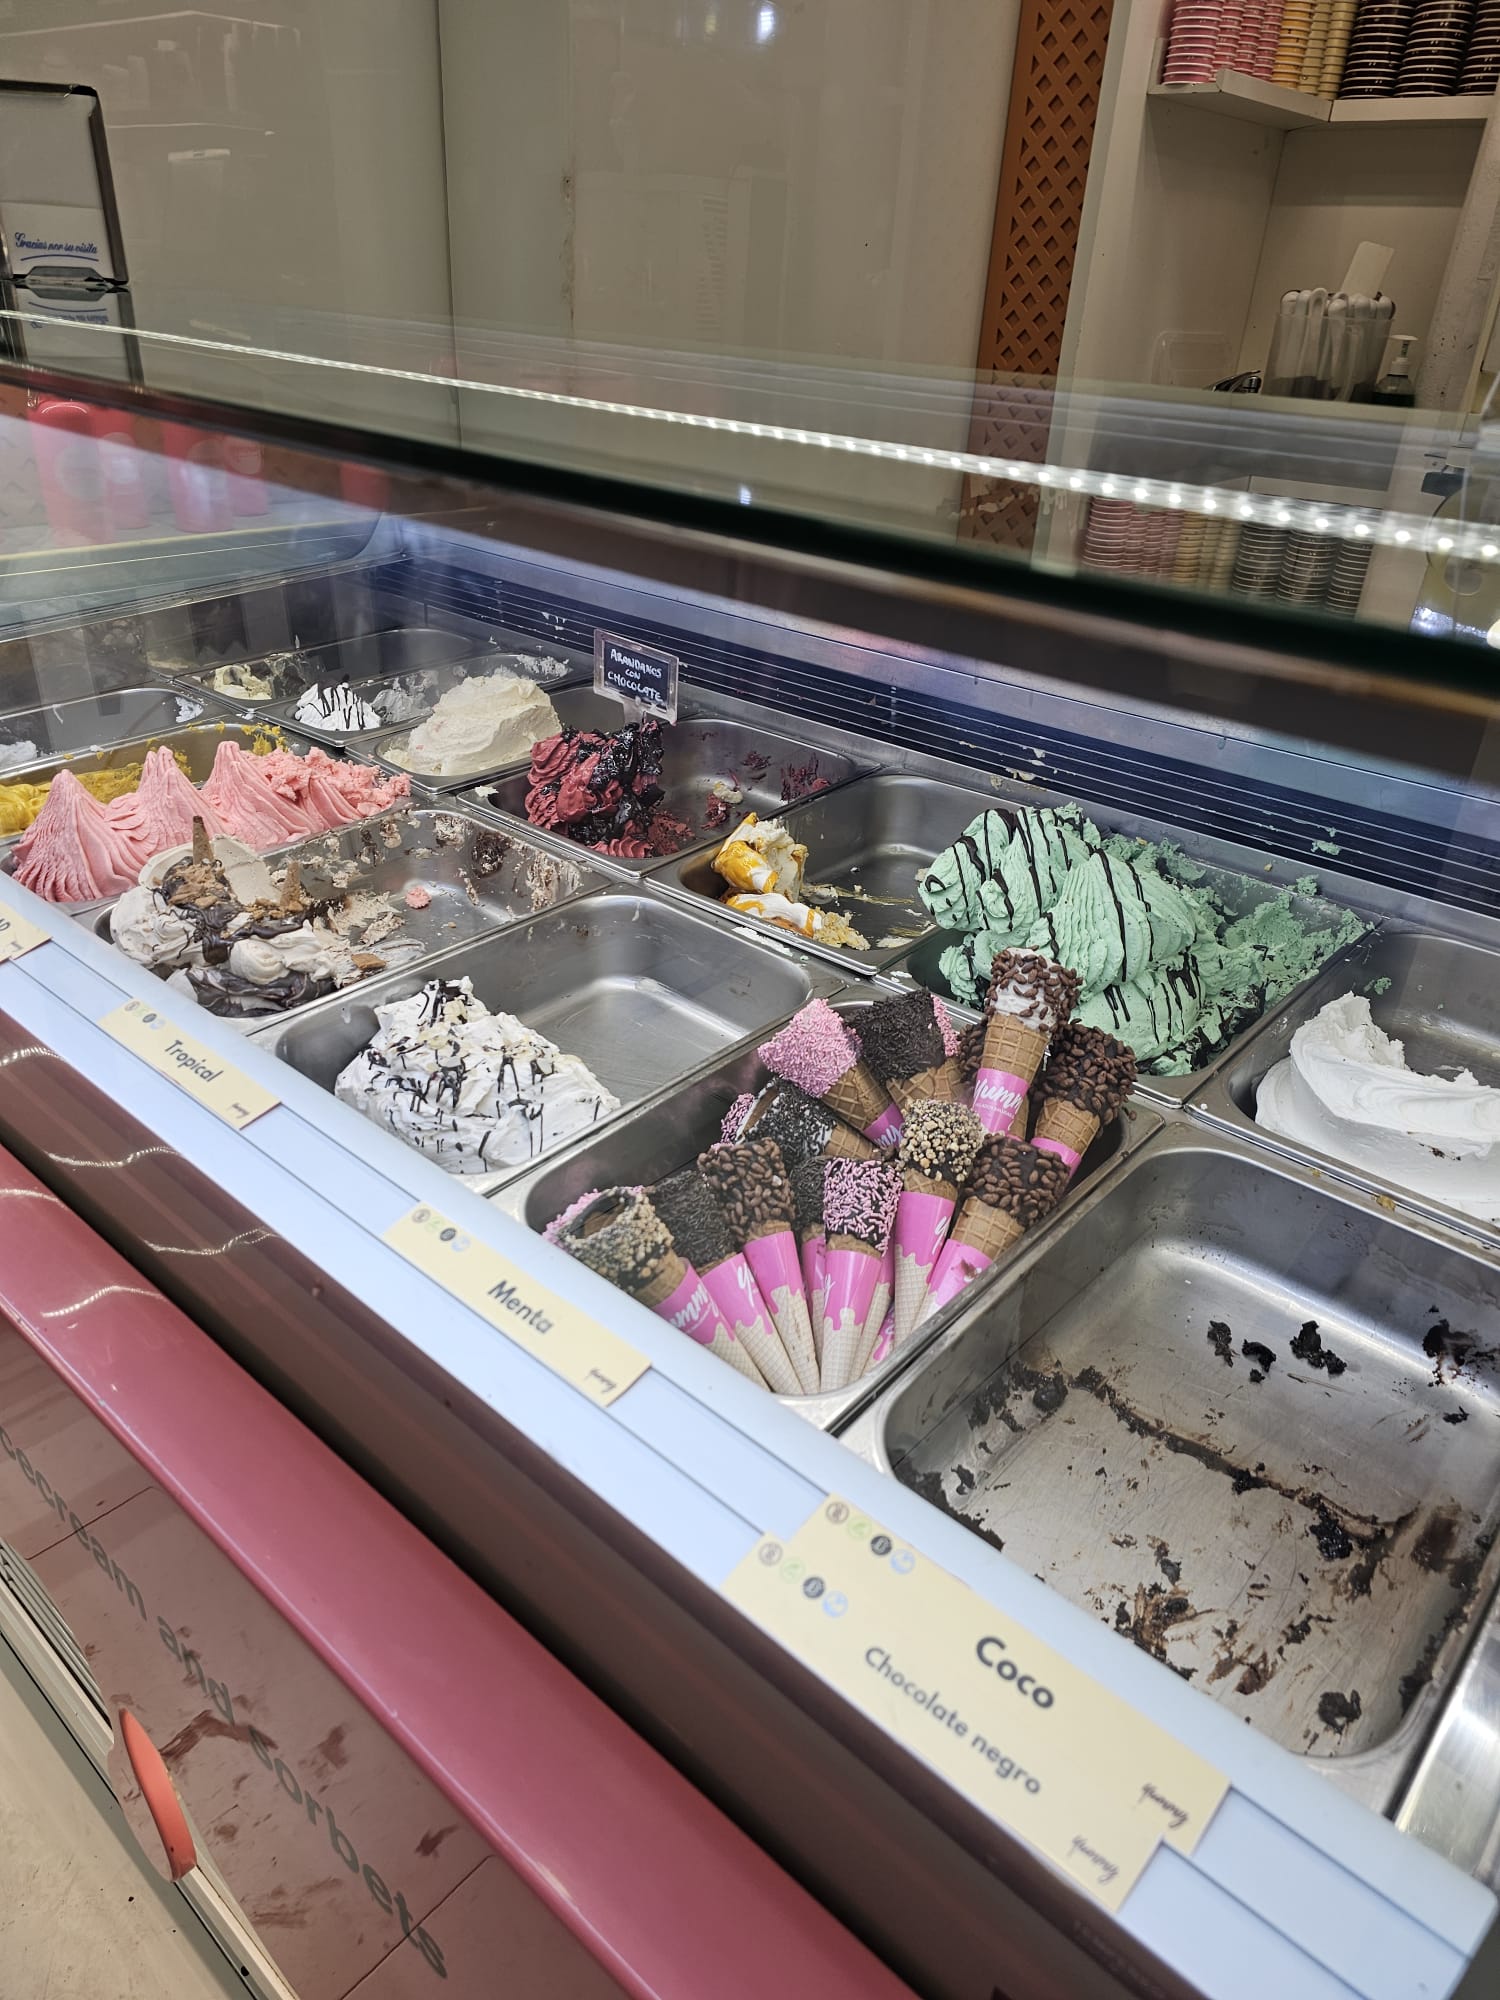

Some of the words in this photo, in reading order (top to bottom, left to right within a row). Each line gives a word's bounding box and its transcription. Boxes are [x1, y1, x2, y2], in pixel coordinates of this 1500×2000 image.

[14, 232, 48, 250] Gracias
[608, 671, 664, 702] CHOCOLATE
[625, 668, 640, 680] CON
[164, 1039, 223, 1083] Tropical
[486, 1280, 553, 1335] Menta
[976, 1635, 1054, 1710] Coco
[865, 1647, 969, 1737] Chocolate
[971, 1733, 1041, 1795] negro
[156, 1615, 235, 1727] and
[248, 1725, 448, 1980] sorbets
